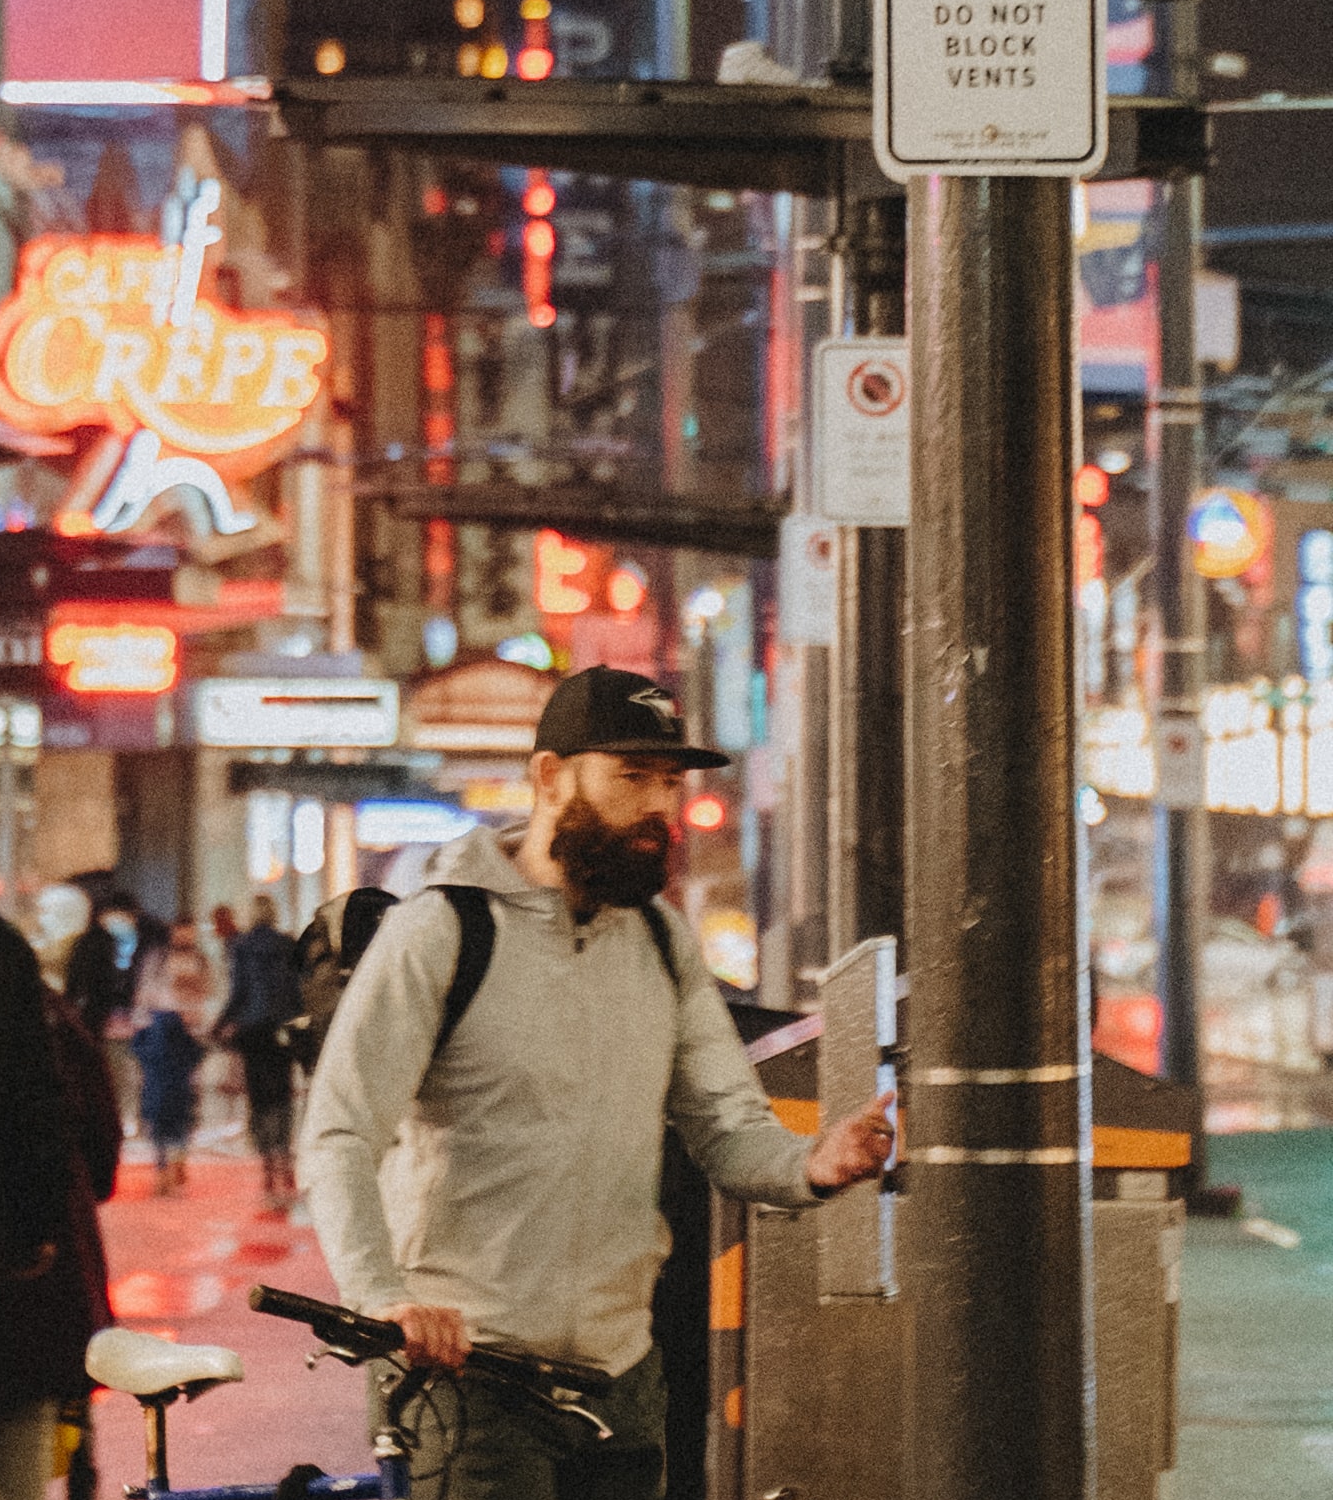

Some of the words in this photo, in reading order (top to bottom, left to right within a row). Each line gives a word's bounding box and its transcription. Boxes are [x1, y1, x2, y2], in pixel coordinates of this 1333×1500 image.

[934, 4, 973, 26] DO
[990, 4, 1046, 26] NOT
[945, 34, 1037, 58] BLOCK
[947, 66, 1037, 89] VENTS
